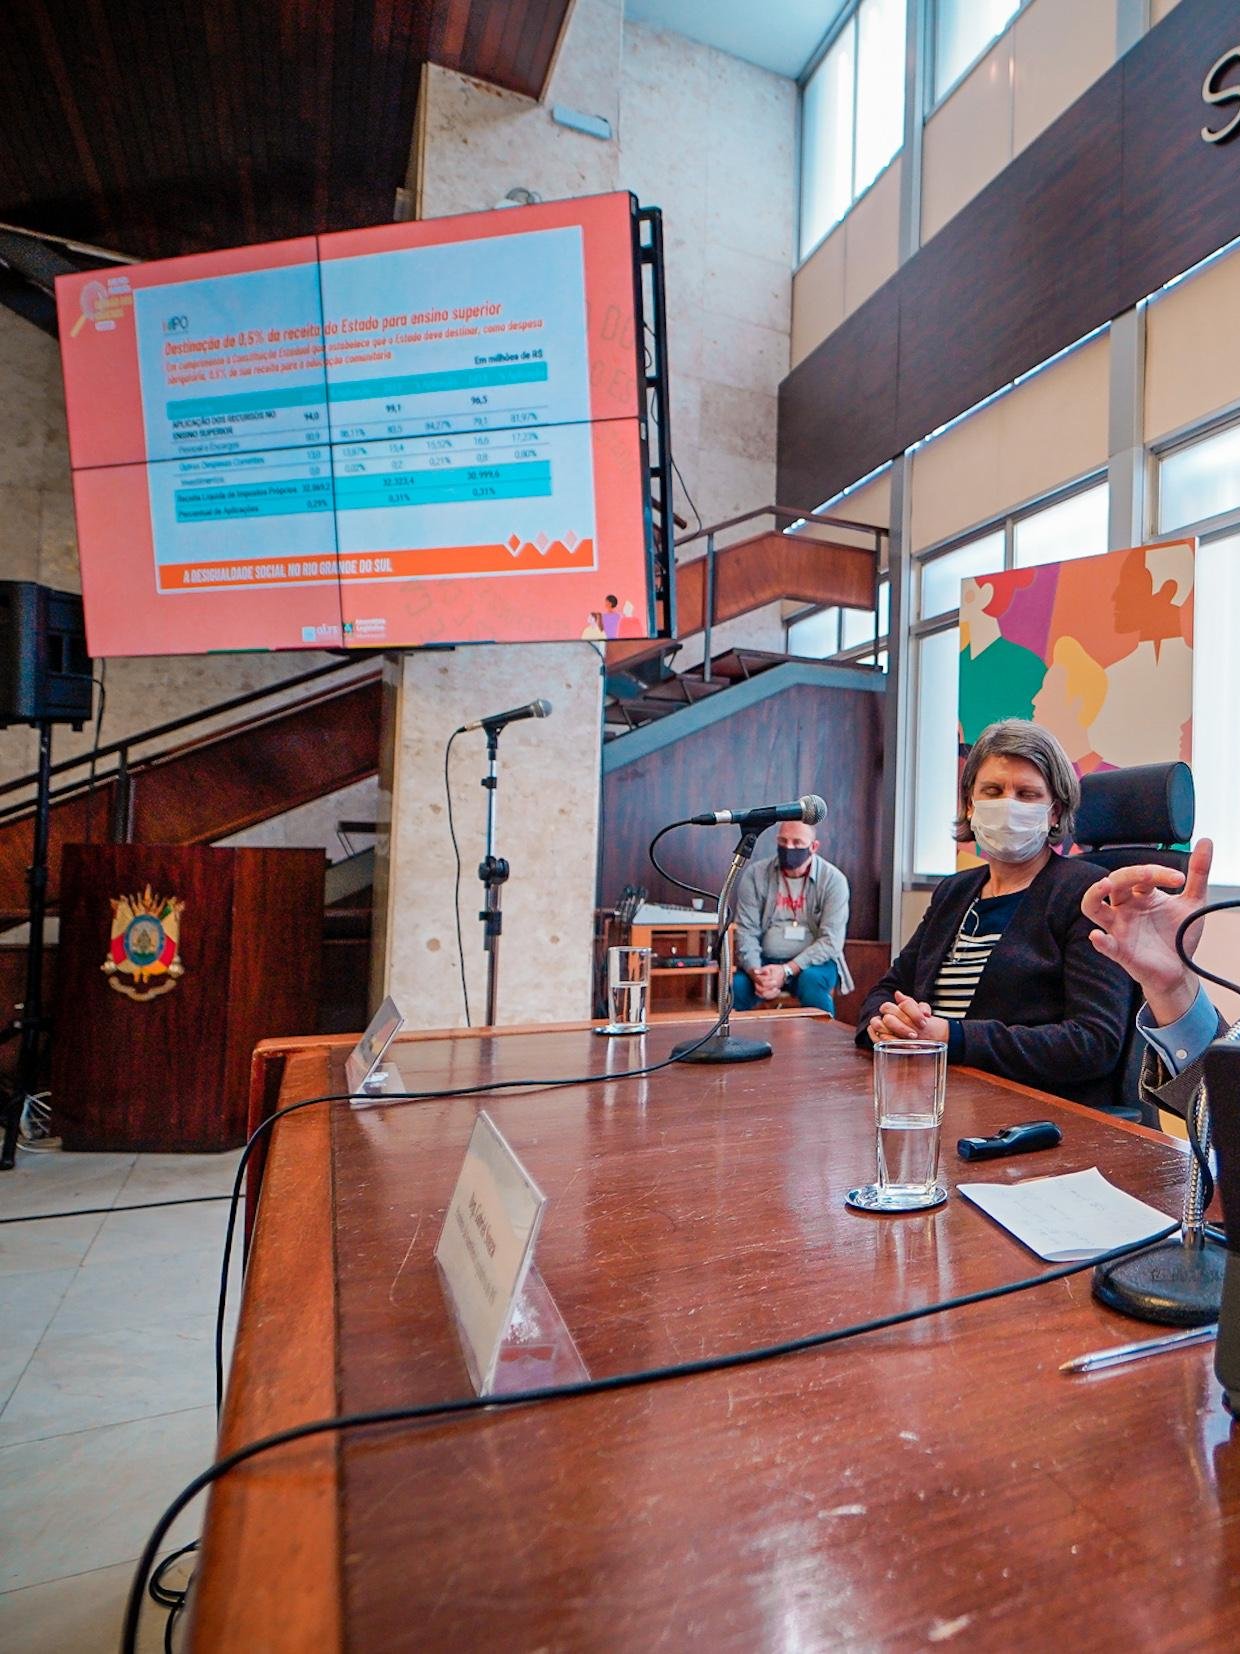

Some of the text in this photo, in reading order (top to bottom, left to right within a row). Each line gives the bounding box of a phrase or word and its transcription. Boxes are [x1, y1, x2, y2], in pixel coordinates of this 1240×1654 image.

[165, 337, 220, 355] Destinação
[238, 332, 264, 346] 0,5%
[283, 325, 320, 341] receita
[324, 322, 337, 336] do
[341, 317, 378, 334] Estado
[382, 316, 407, 330] para
[411, 306, 448, 325] ensino
[452, 300, 501, 322] superior
[328, 338, 370, 352] estabelece
[373, 338, 386, 349] que
[395, 332, 421, 344] Estado
[424, 329, 442, 341] deve
[483, 322, 505, 334] como
[508, 318, 542, 332] despesa
[474, 355, 486, 365] Em
[488, 351, 518, 364] milhões
[532, 348, 542, 359] R$
[385, 403, 401, 413] 99,1
[470, 394, 487, 405] 96,5
[182, 557, 392, 583] A DESIGUALDADE SOCIAL NO RIO GRANDE DO SUL
